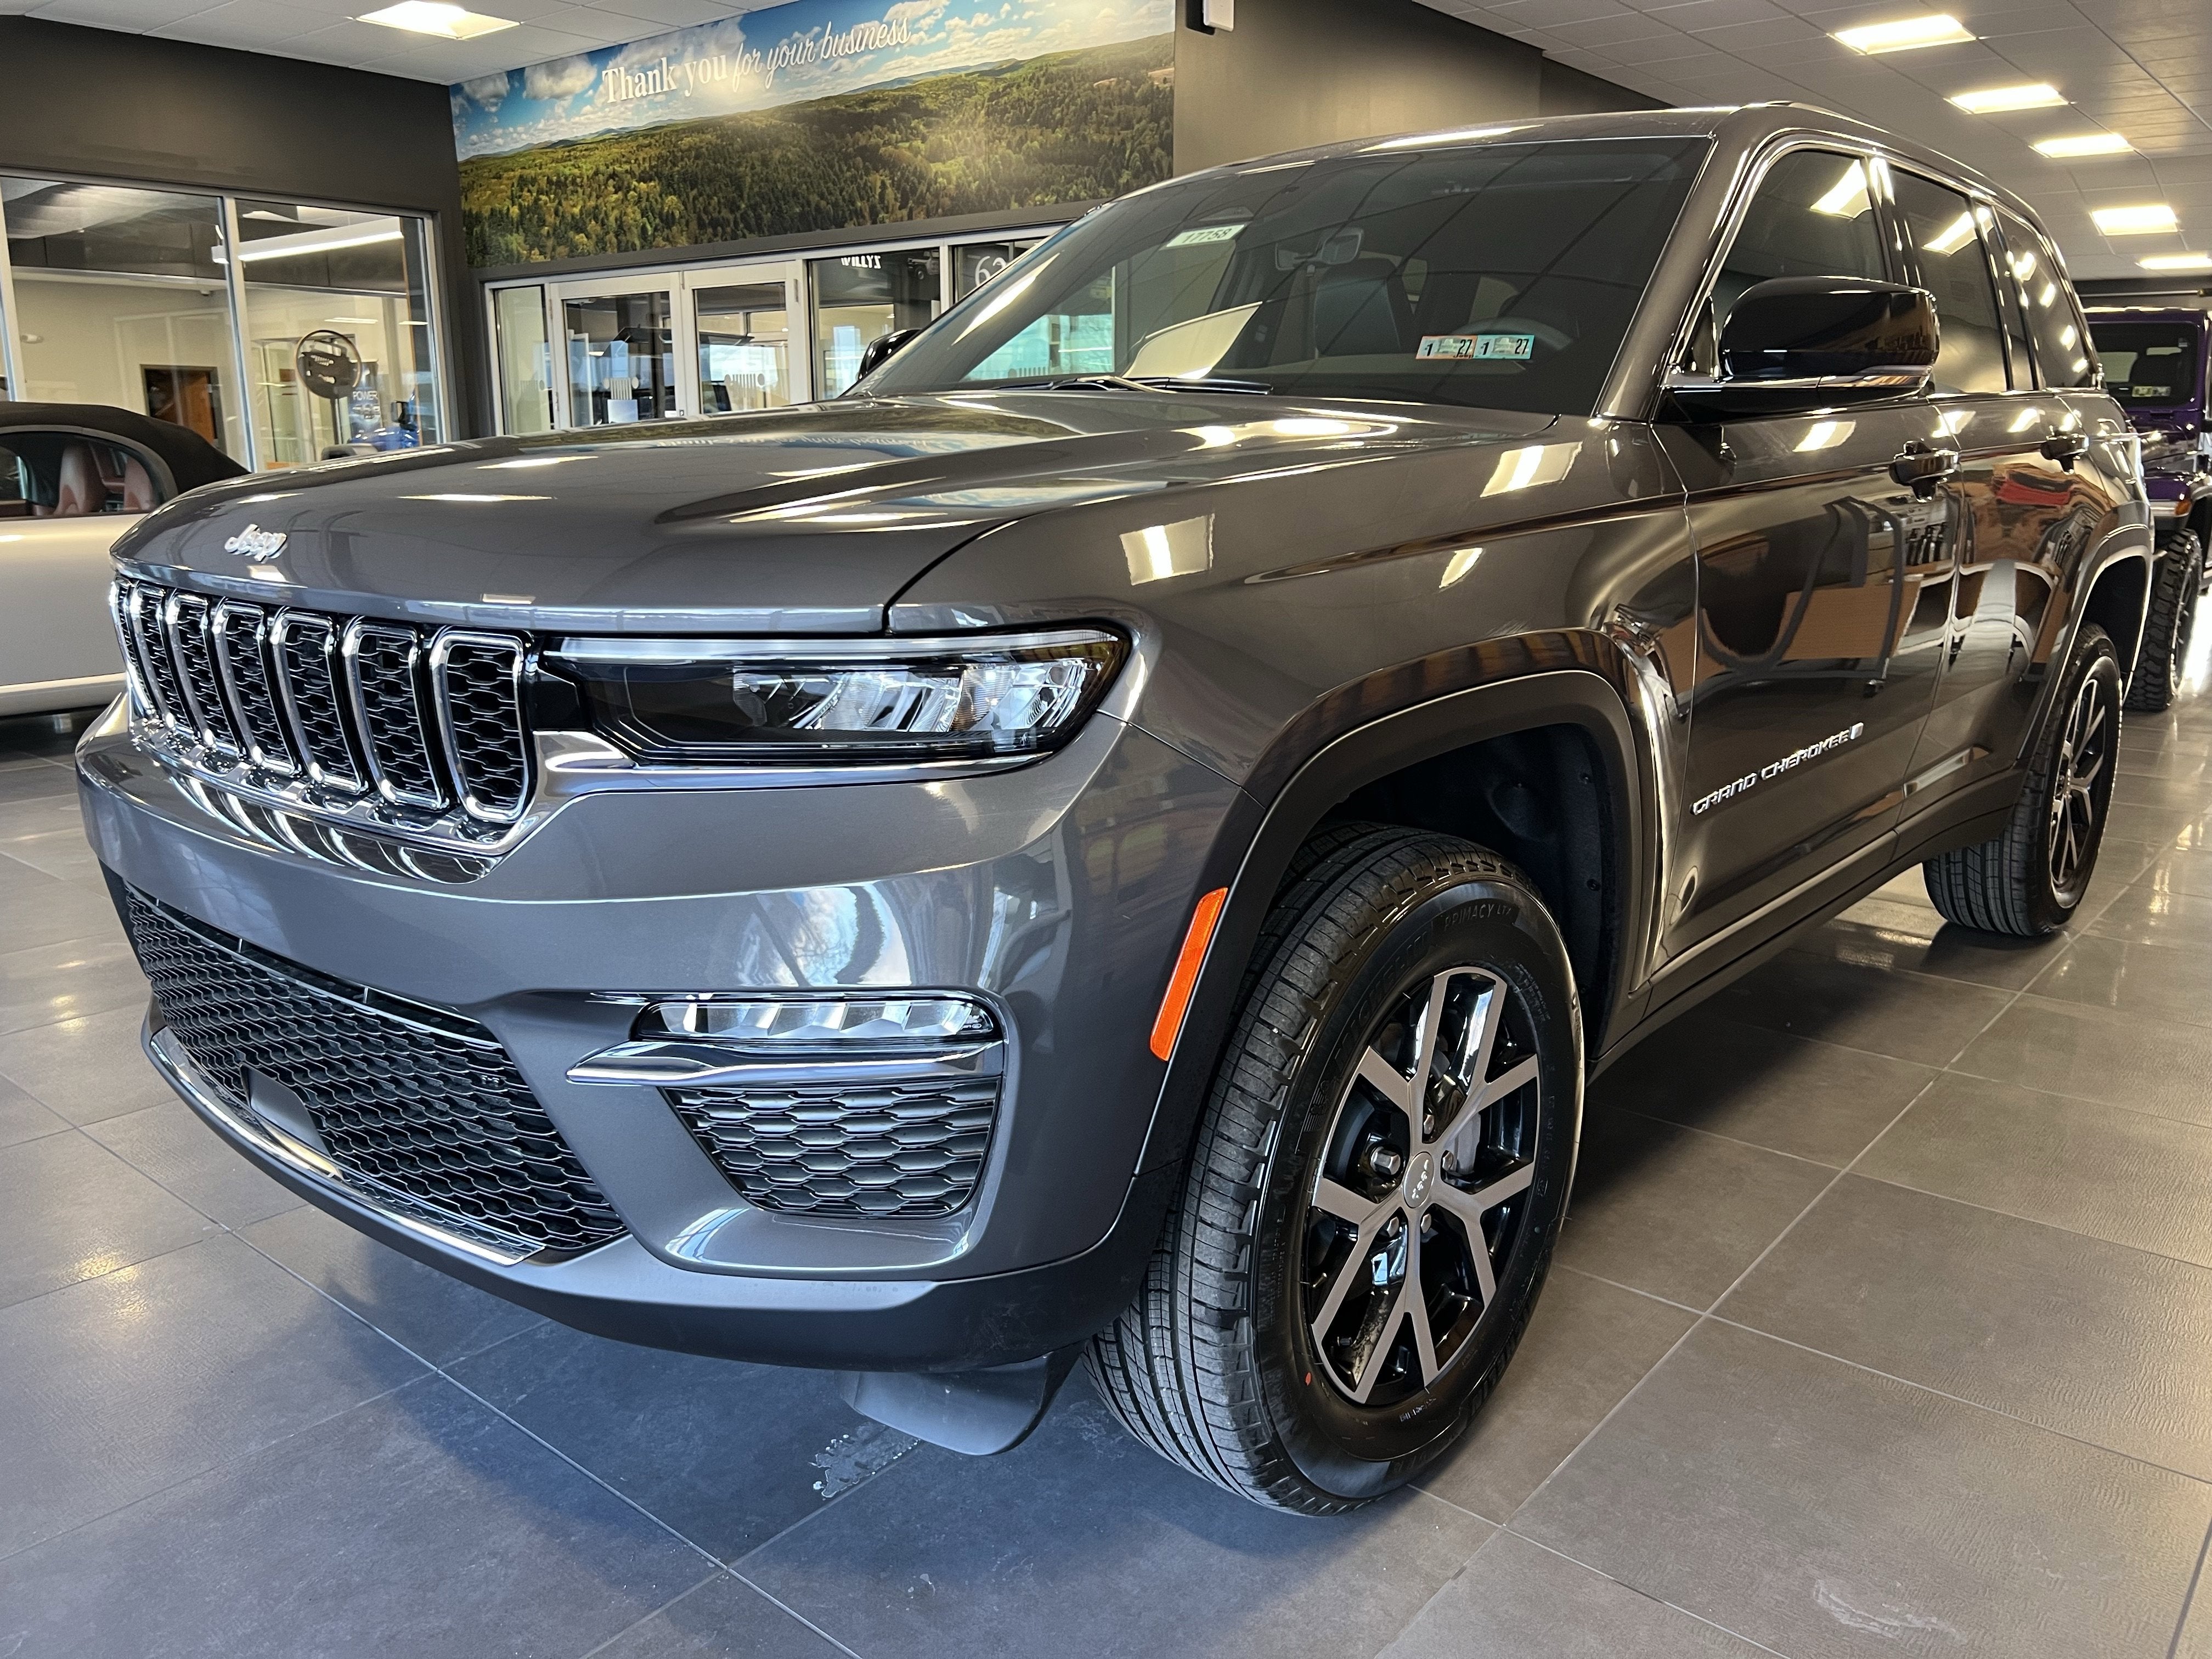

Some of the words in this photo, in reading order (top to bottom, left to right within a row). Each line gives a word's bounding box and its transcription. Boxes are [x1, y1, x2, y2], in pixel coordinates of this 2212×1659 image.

[602, 57, 678, 104] Thank
[685, 55, 728, 97] you
[732, 43, 764, 93] for
[765, 38, 816, 89] your
[820, 17, 911, 59] business
[1181, 228, 1232, 244] 17758
[840, 255, 881, 269] WILLYS
[1426, 343, 1434, 356] 1
[1457, 339, 1473, 355] 27
[1482, 341, 1490, 355] 1
[1514, 338, 1530, 354] 27
[352, 390, 379, 401] POWER
[224, 523, 287, 563] Jeep
[1690, 772, 1757, 815] GRAND
[1759, 729, 1849, 780] CHEROKEE
[1444, 903, 1494, 932] PRIMACY
